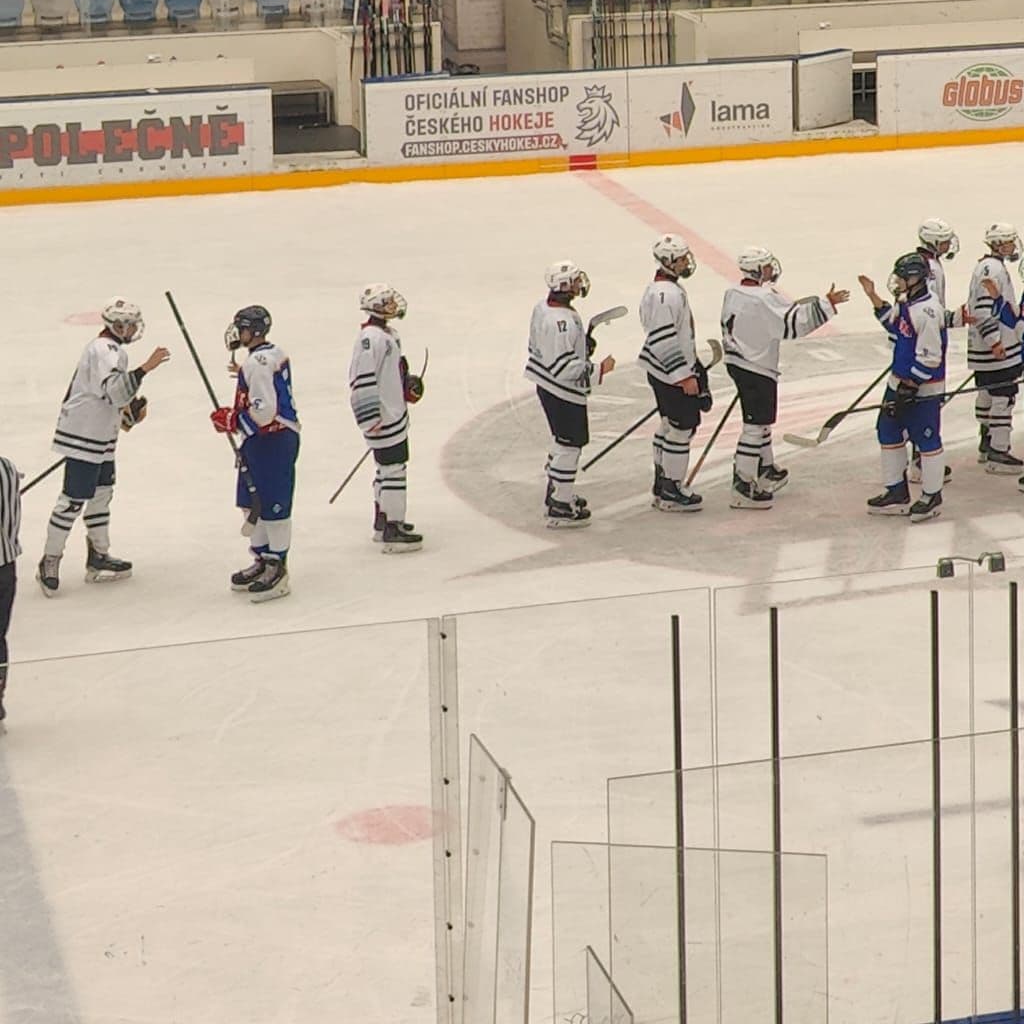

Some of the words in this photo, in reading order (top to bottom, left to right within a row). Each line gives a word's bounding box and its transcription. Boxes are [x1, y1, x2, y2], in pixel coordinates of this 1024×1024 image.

[405, 85, 488, 111] OFICIÁLNÍ
[493, 86, 569, 107] FANSHOP
[711, 100, 770, 122] lama
[405, 113, 483, 136] ČESKÉHO
[489, 112, 554, 132] HOKEJE
[405, 135, 558, 158] FANSHOP.CESKYHOKEJ.CZ
[557, 320, 568, 333] 12
